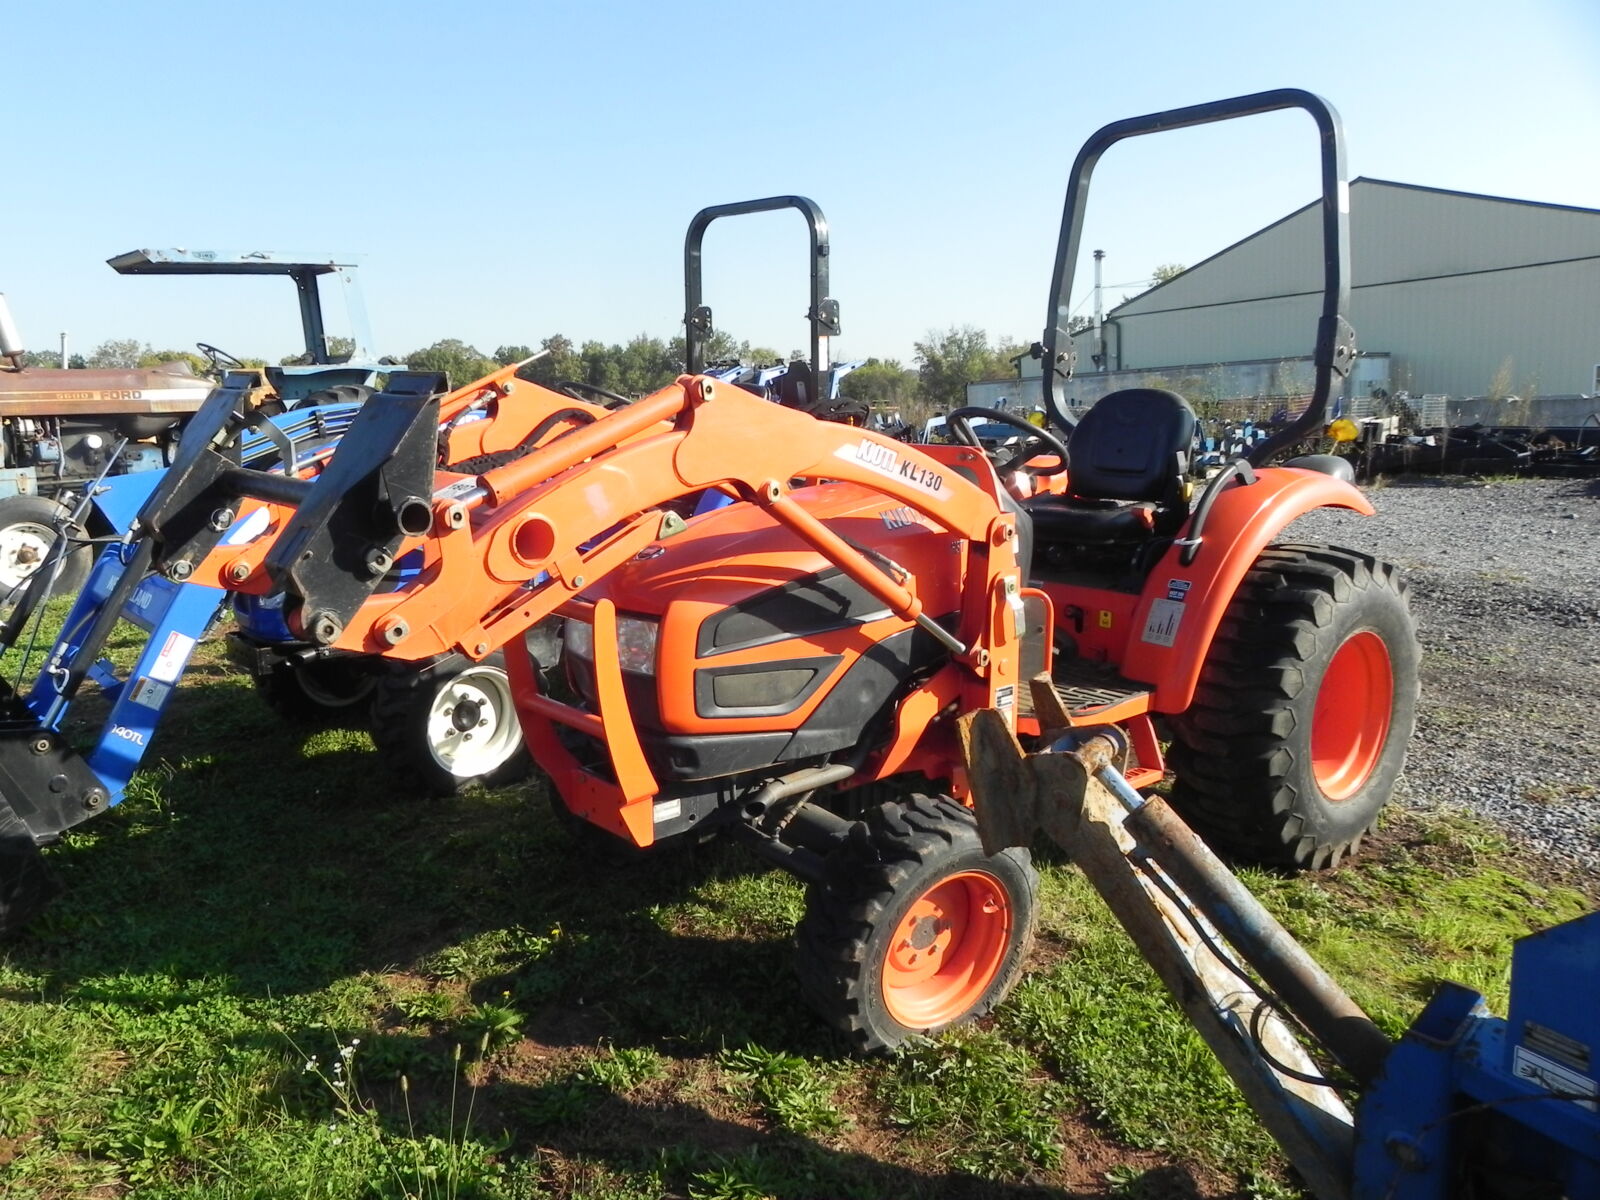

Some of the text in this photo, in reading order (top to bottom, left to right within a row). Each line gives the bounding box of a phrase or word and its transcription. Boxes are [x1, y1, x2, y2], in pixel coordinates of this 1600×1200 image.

[101, 390, 142, 400] FORD
[856, 438, 943, 491] KIOTI KL130
